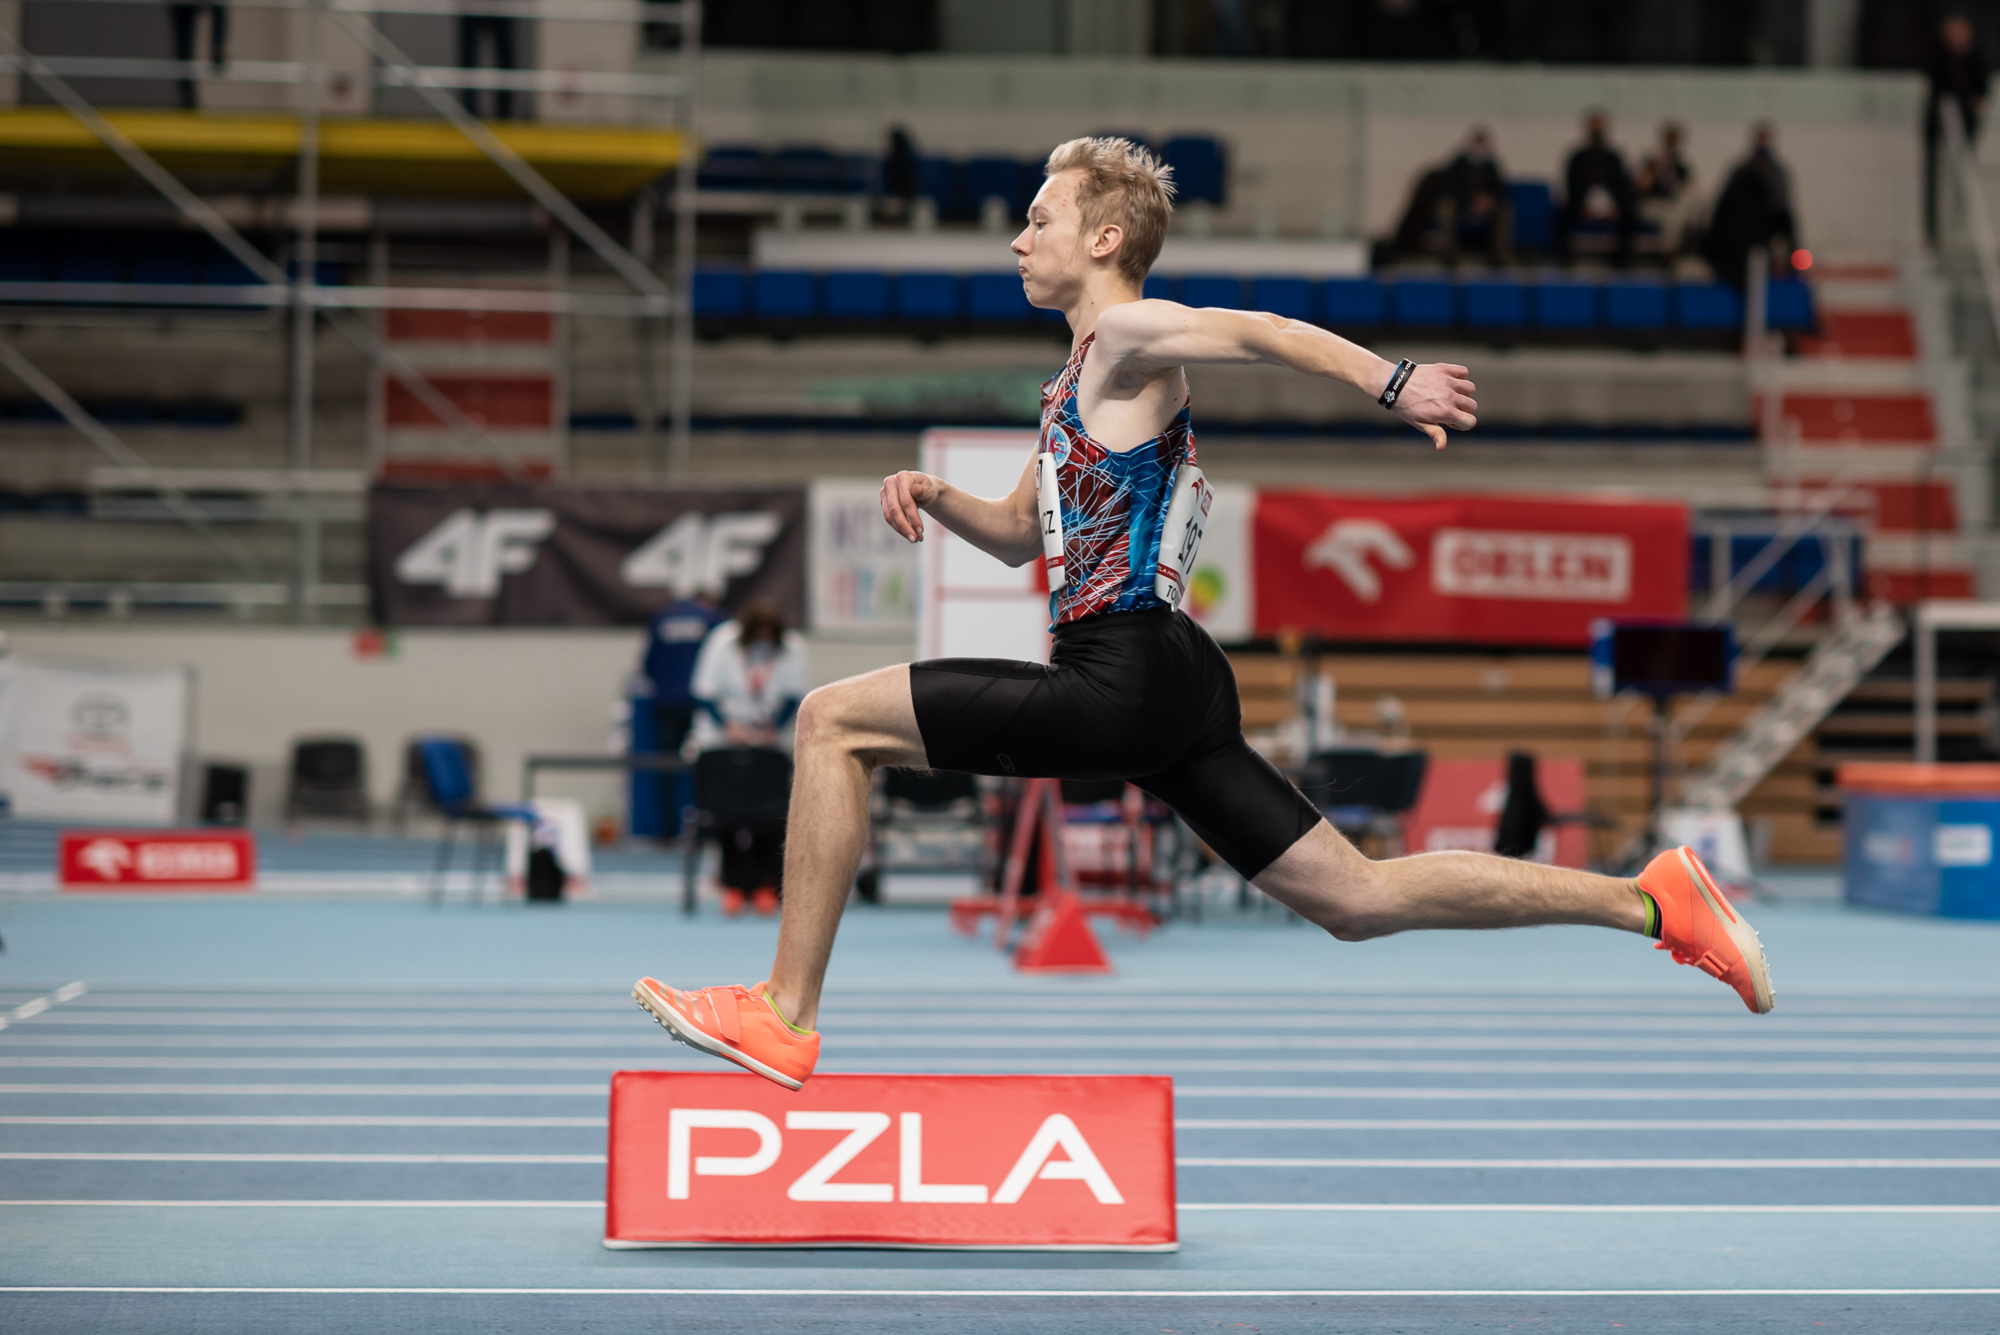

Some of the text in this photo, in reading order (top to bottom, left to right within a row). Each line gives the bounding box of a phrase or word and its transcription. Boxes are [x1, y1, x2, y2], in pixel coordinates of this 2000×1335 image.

[1393, 370, 1406, 390] BREAK
[394, 508, 557, 598] 4F
[622, 510, 783, 598] 4F
[667, 1108, 1125, 1205] PZLA
